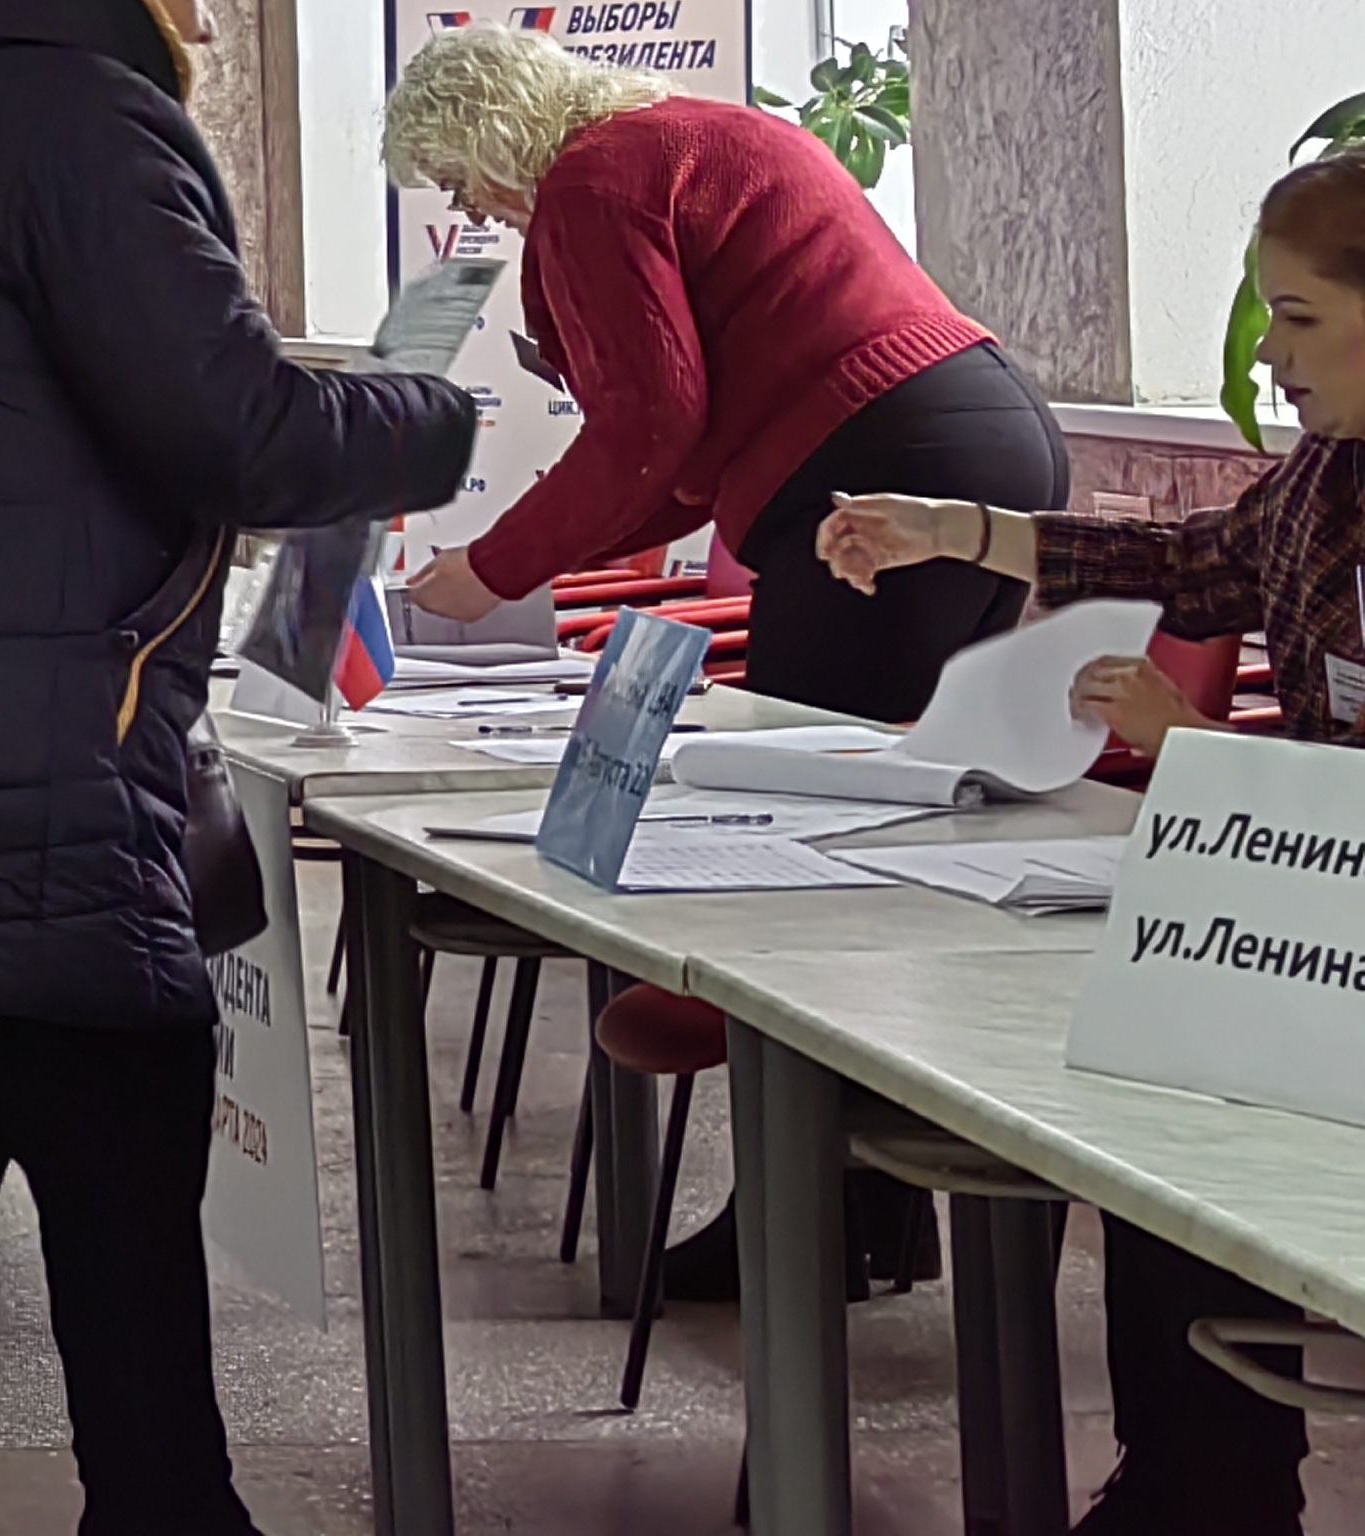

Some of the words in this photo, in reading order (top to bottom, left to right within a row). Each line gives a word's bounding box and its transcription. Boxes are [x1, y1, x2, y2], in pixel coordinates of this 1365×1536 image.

[566, 0, 681, 35] ВЫБОРЫ
[1146, 813, 1365, 878] ул.Ленин
[1131, 916, 1365, 992] ул.Ленина
